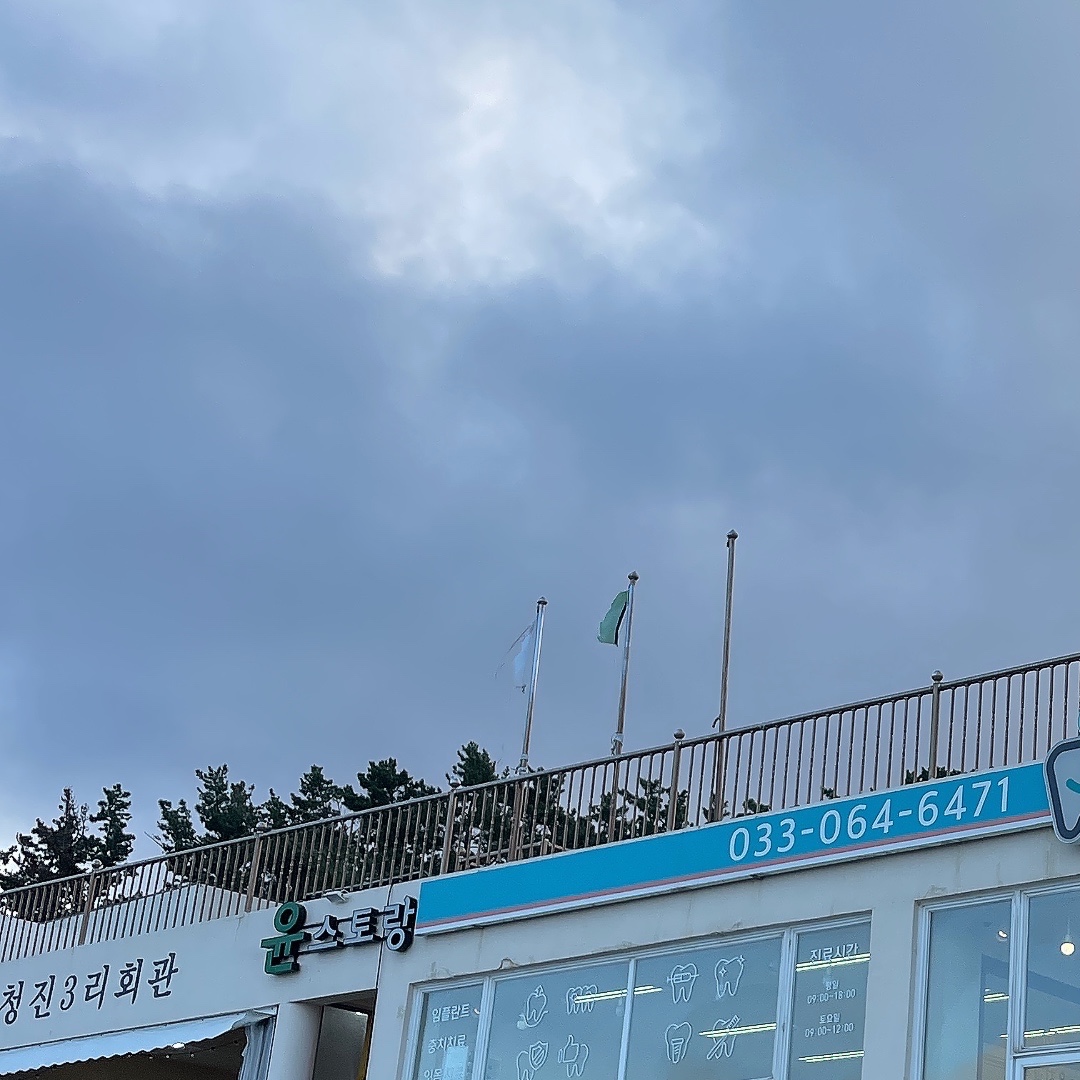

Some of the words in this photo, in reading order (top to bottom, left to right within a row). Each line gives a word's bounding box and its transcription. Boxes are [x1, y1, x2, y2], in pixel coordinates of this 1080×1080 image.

[728, 776, 1010, 862] 033-064-6471
[260, 894, 418, 976] 윤스토랑
[0, 952, 179, 1025] 청진3리회관
[432, 1003, 470, 1023] 임플란트
[819, 1013, 840, 1025] 토요일
[428, 1034, 467, 1054] 충치치료
